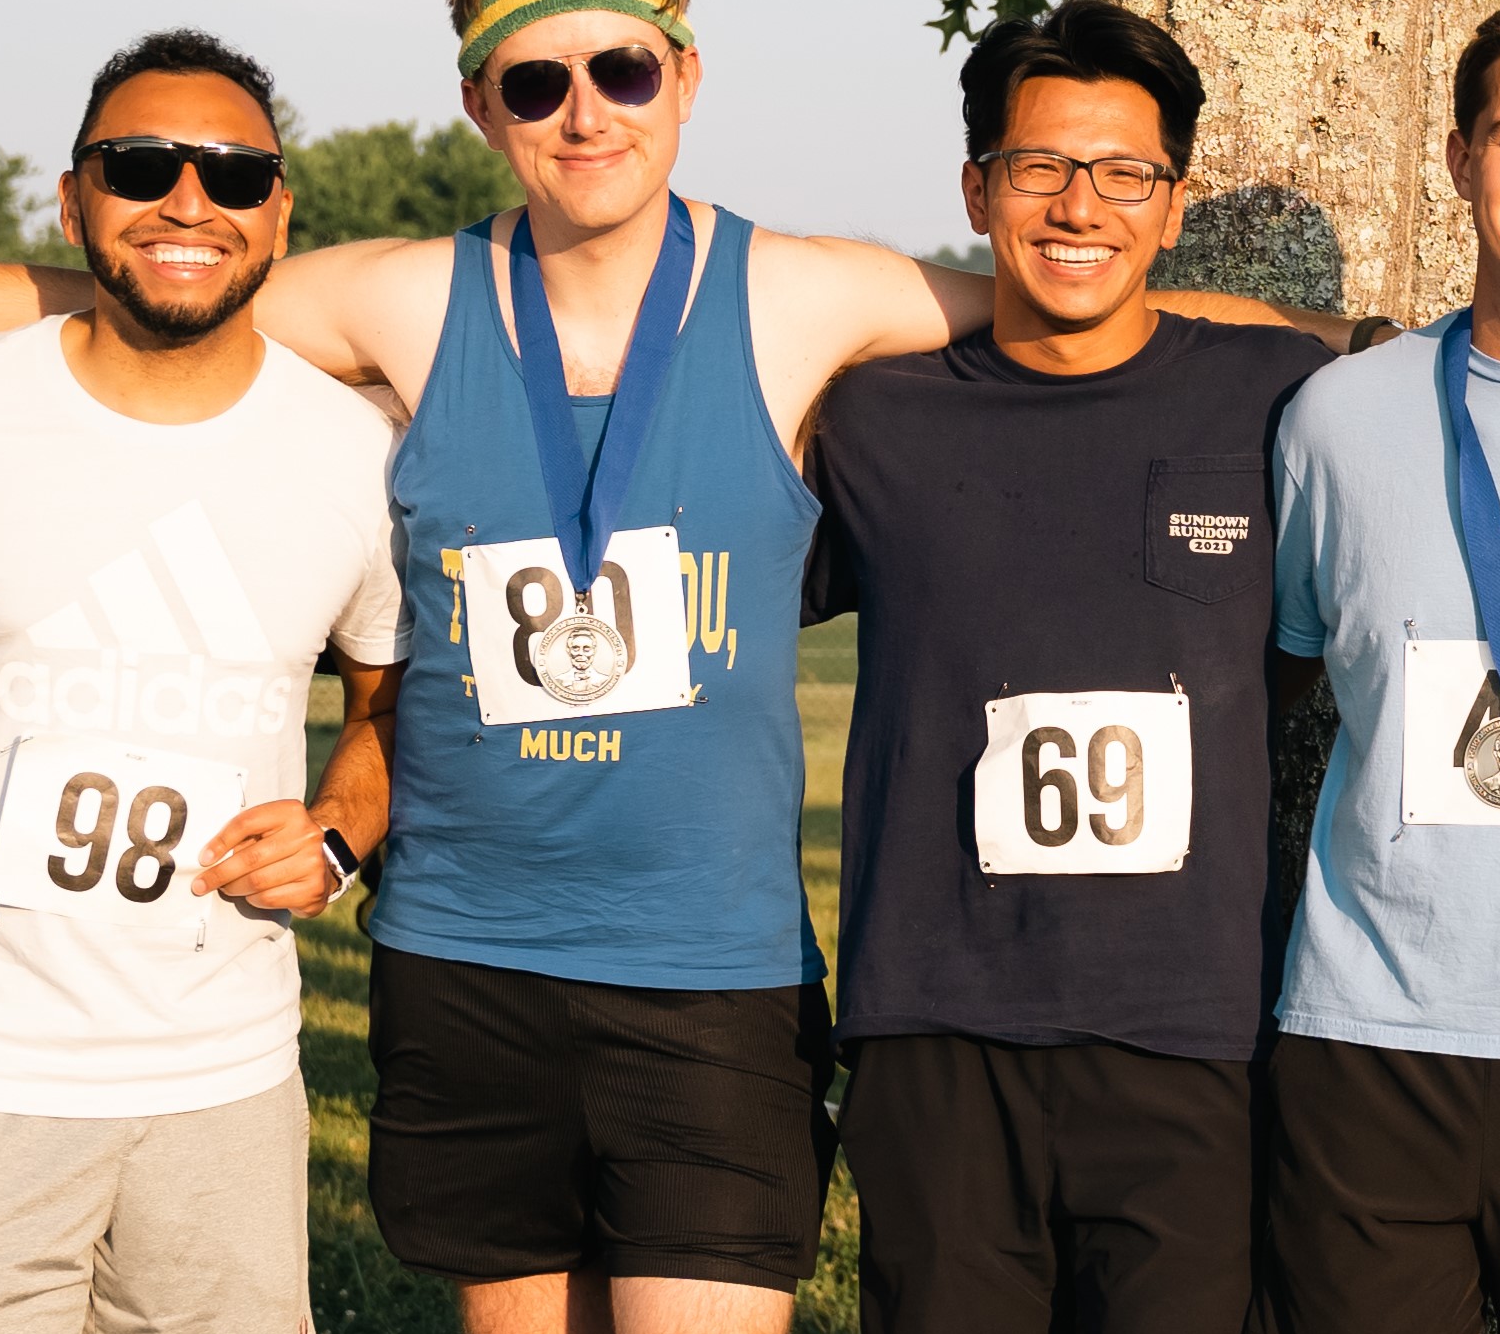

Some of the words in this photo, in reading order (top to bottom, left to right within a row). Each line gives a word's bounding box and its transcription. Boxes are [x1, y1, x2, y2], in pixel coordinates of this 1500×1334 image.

[1168, 525, 1249, 540] RUNDOWN
[1169, 513, 1250, 528] SUNDOWN
[1194, 541, 1229, 552] 2021
[519, 727, 622, 762] MUCH
[1022, 724, 1144, 848] 69
[47, 771, 188, 903] 98
